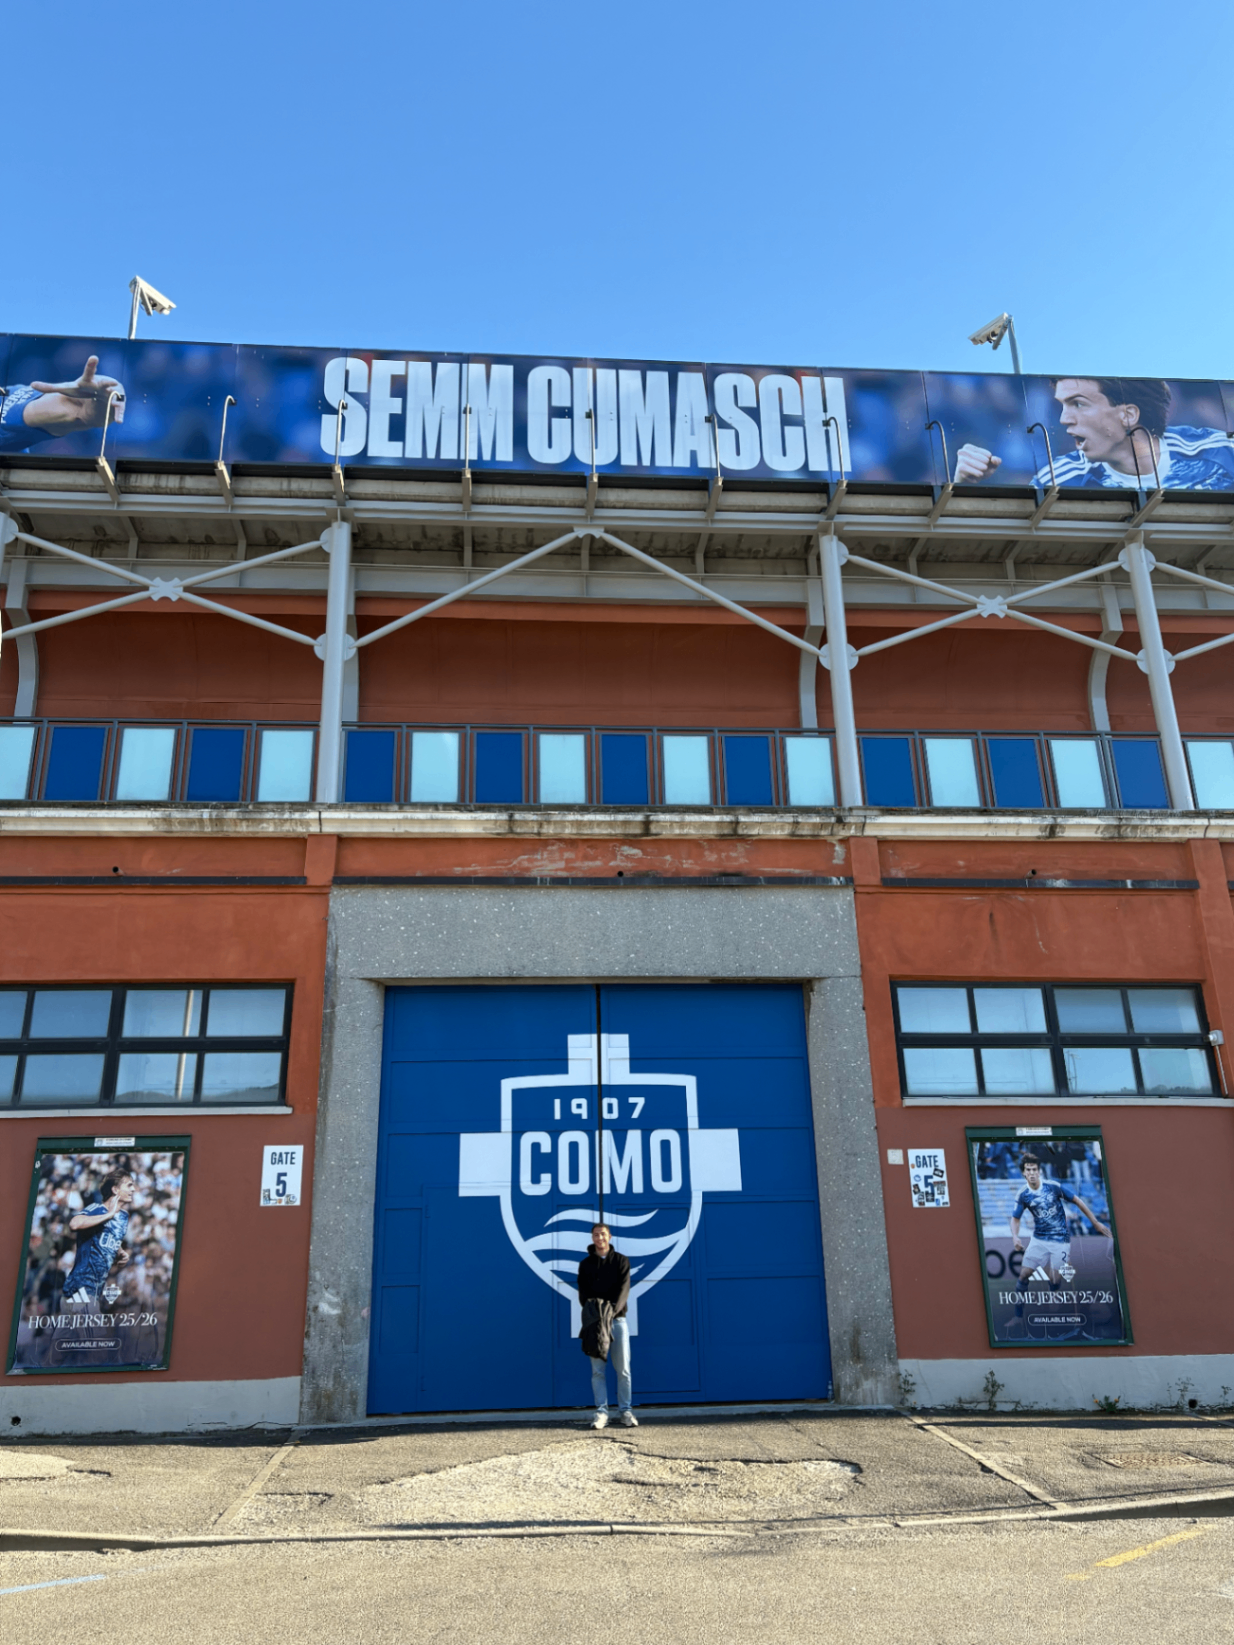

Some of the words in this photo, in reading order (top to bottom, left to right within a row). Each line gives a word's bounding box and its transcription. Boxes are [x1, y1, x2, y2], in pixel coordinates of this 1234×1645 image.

[320, 357, 514, 461] SEMM
[527, 365, 852, 472] CUMASCH
[554, 1097, 645, 1120] 1907
[270, 1151, 296, 1165] GATE
[519, 1129, 682, 1195] COMO
[915, 1155, 939, 1168] GATE
[275, 1172, 288, 1197] 5
[924, 1175, 935, 1200] 5
[99, 1232, 122, 1250] Ube
[1079, 1290, 1114, 1304] 25/26
[119, 1312, 158, 1327] 25/26
